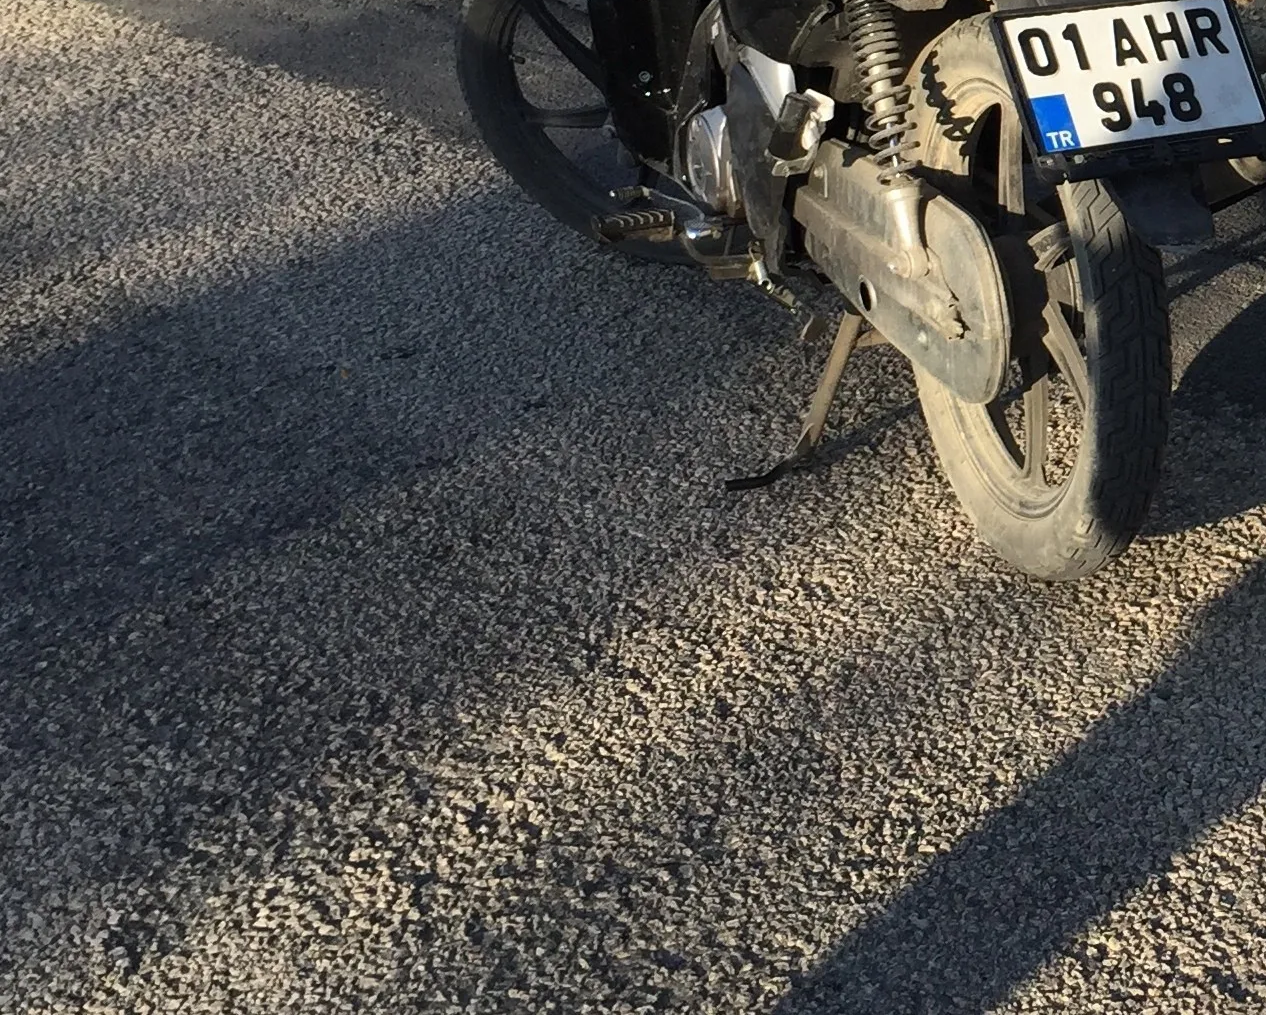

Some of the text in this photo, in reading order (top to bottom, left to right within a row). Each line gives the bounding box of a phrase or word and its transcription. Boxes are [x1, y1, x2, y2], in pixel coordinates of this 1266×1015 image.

[1017, 8, 1229, 76] 01 AHR
[1093, 73, 1202, 132] 948
[1046, 130, 1075, 148] TR
